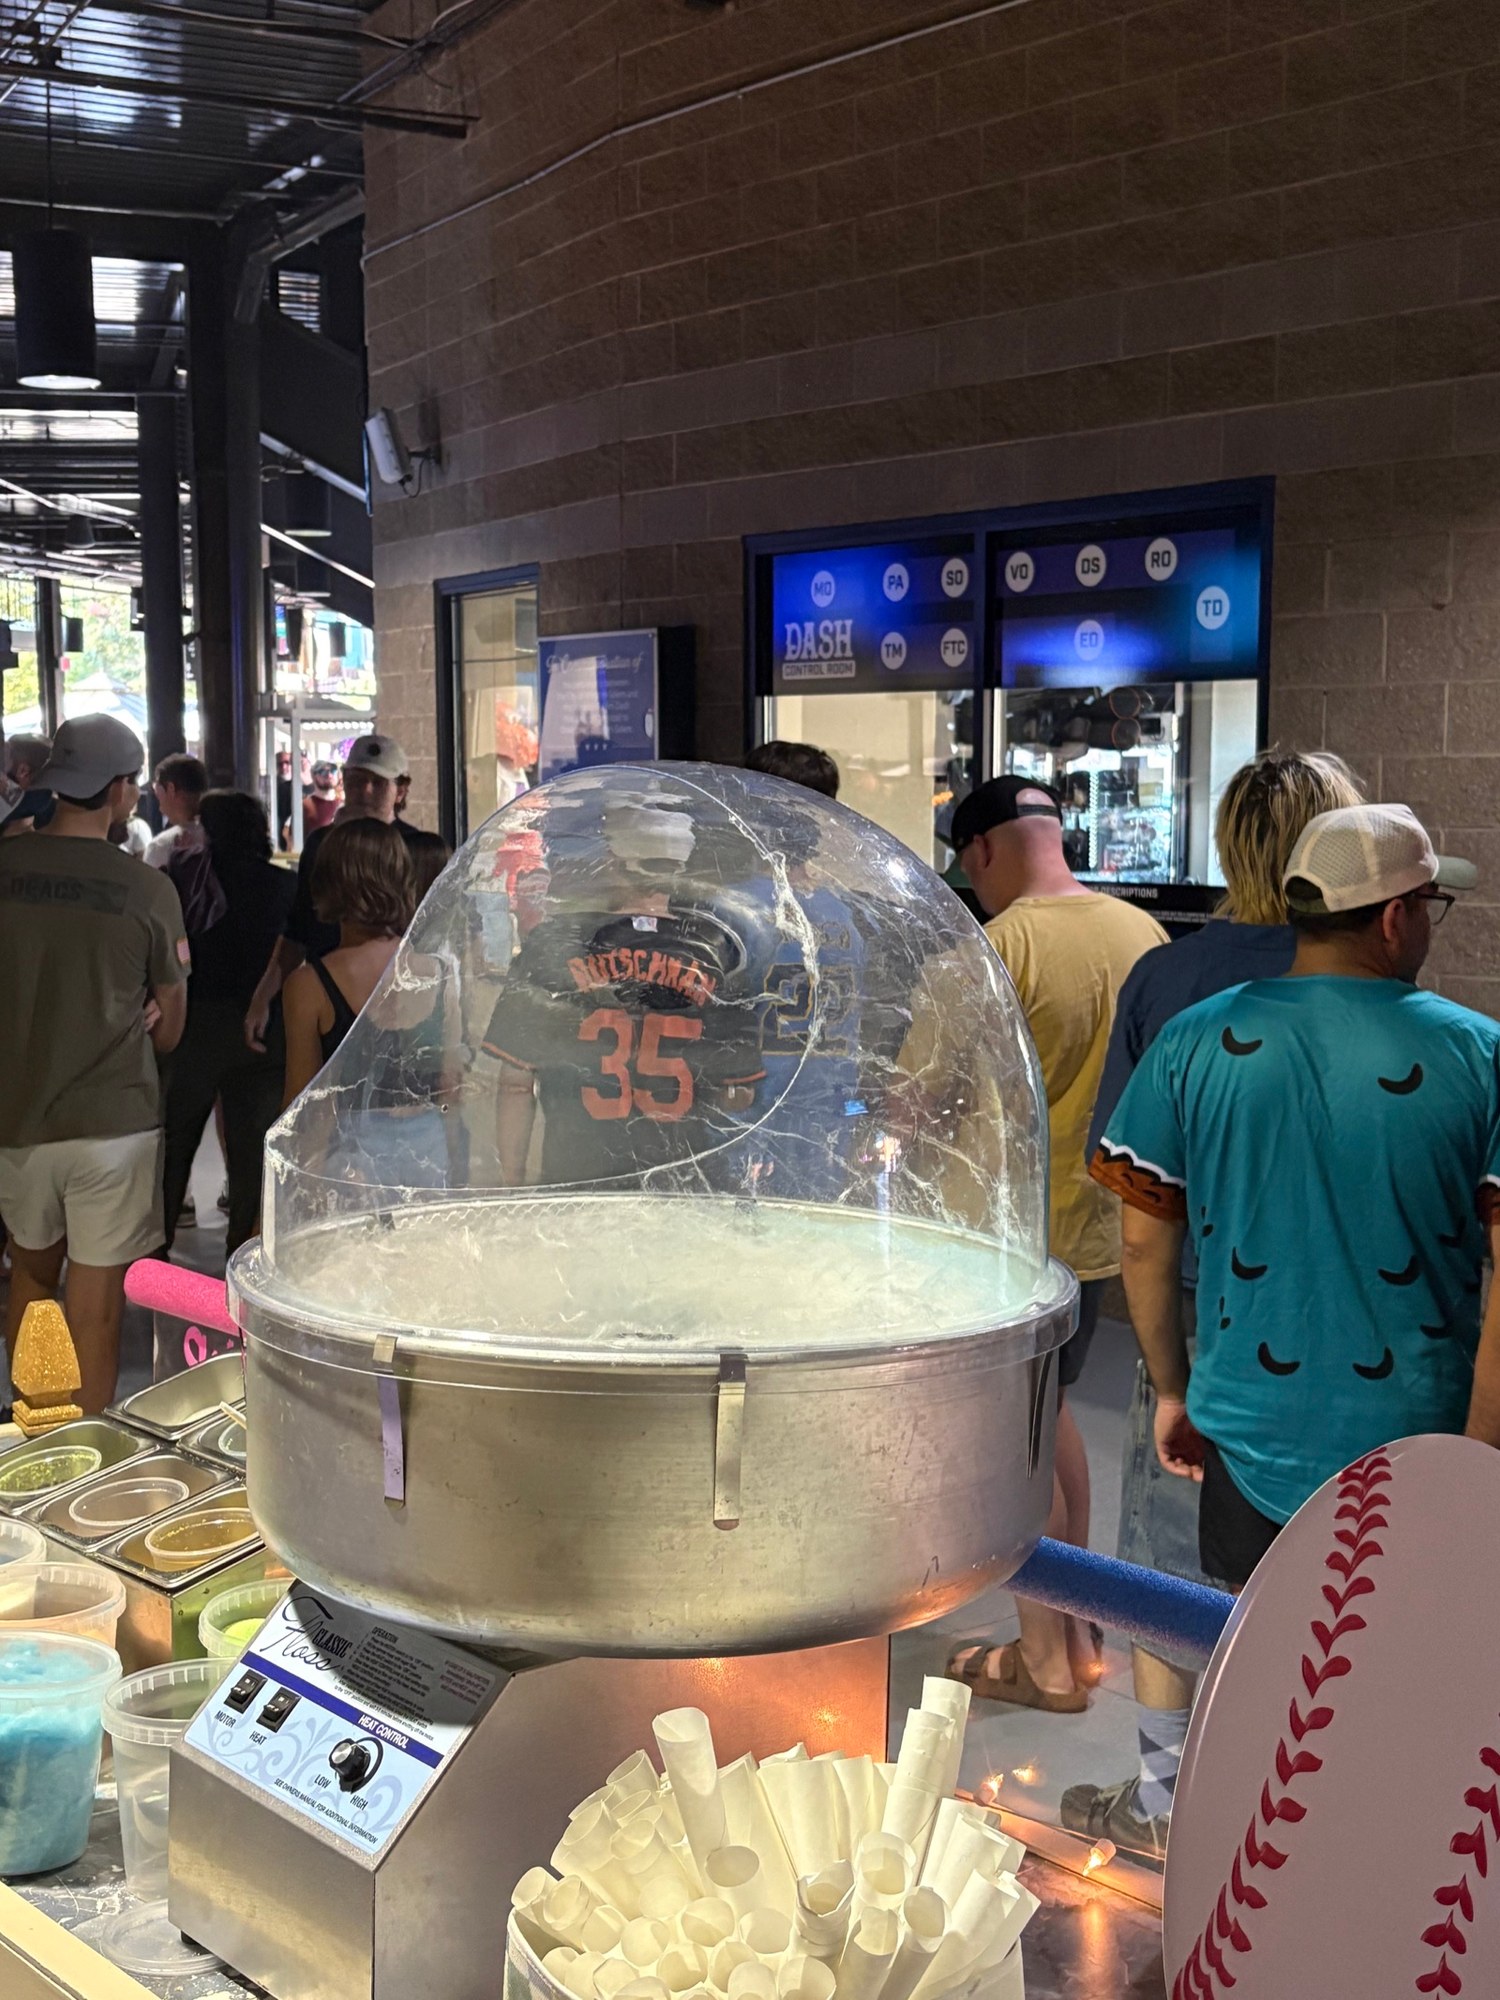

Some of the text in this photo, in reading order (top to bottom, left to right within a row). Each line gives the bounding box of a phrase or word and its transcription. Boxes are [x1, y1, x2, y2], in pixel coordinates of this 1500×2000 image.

[1081, 557, 1100, 575] DS
[1151, 550, 1171, 568] RO
[946, 570, 963, 586] SO
[1010, 563, 1028, 580] VO
[888, 575, 904, 590] PA
[1202, 599, 1223, 617] TD
[784, 619, 854, 661] DASH
[943, 640, 965, 655] FTC
[1080, 632, 1098, 648] EO
[884, 643, 902, 659] TM
[785, 662, 854, 677] CONTROL ROOM
[1101, 885, 1158, 899] DESCRIPTIONS
[578, 1008, 701, 1121] 35
[312, 1628, 353, 1658] CLASSIC
[215, 1709, 237, 1728] MOTOR
[249, 1730, 267, 1746] HEAT
[358, 1714, 409, 1748] HEAT CONTROL
[314, 1774, 331, 1789] LOW
[274, 1778, 283, 1787] SEE
[299, 1793, 316, 1807] MANUAL
[316, 1803, 327, 1813] FOR
[326, 1808, 349, 1827] ADDITIONAL
[348, 1823, 378, 1844] INFORMATION
[350, 1795, 368, 1811] HIGH
